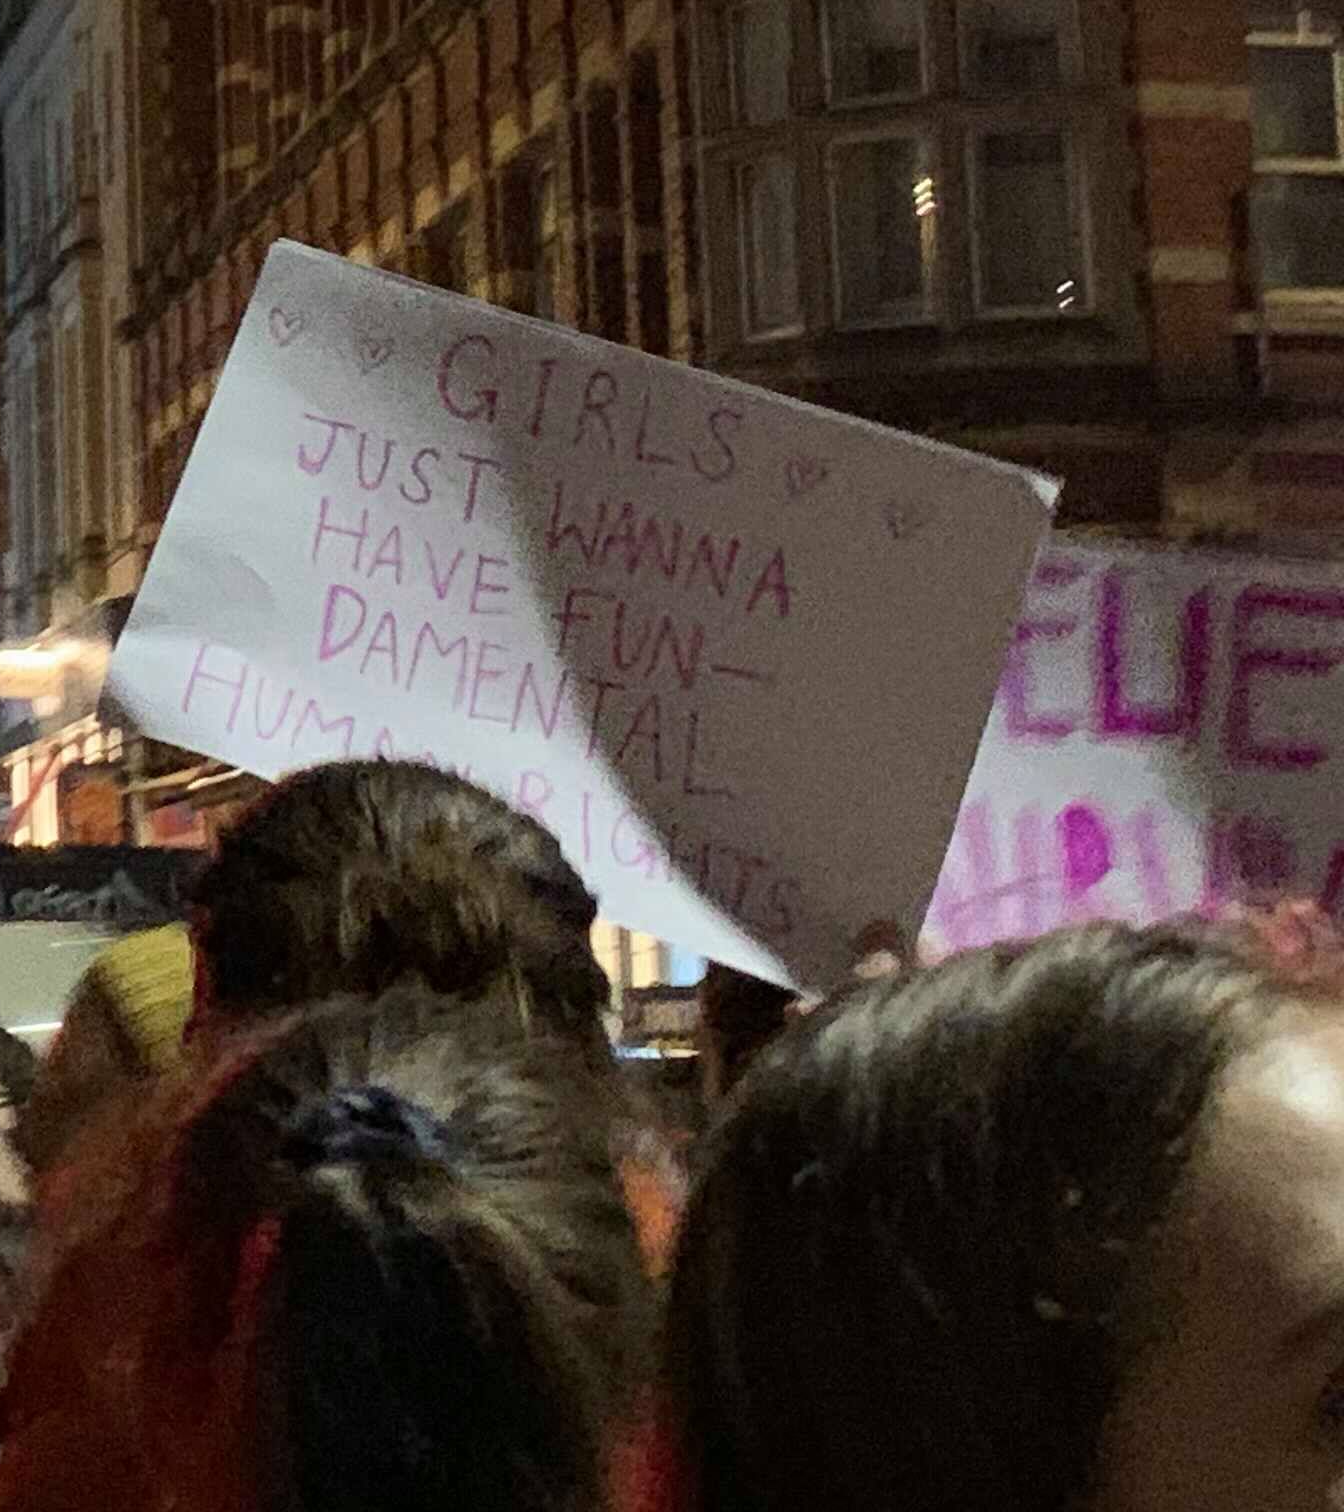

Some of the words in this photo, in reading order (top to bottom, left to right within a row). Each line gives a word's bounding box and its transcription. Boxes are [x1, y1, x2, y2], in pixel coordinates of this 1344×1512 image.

[435, 333, 743, 482] GIRLS
[295, 412, 503, 524] JUST
[544, 478, 791, 618] WANNA
[312, 497, 513, 615] HAVE
[316, 584, 735, 799] DAMENTAL
